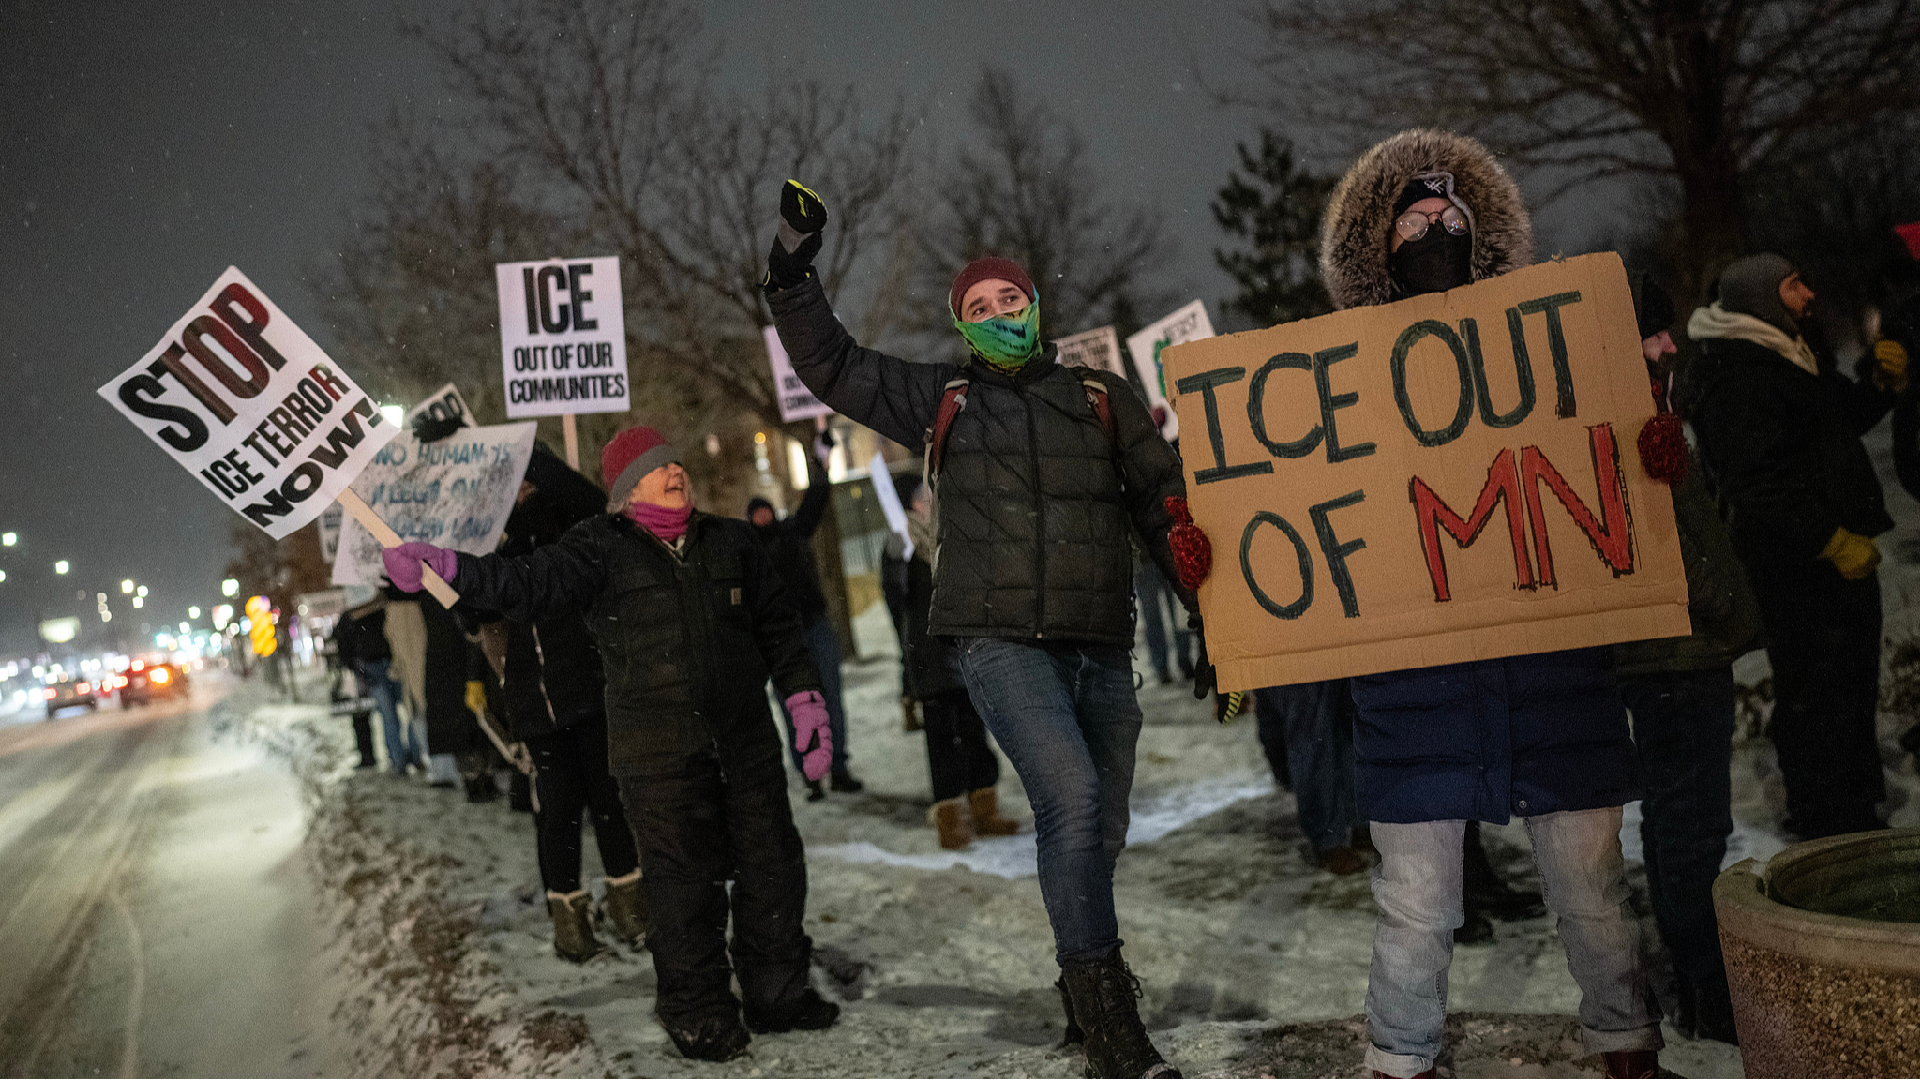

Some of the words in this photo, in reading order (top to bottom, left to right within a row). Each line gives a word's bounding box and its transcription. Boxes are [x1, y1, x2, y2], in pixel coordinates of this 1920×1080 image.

[514, 345, 548, 372] OUT
[552, 344, 574, 370] OF
[577, 342, 613, 369] OUR
[522, 263, 599, 335] ICE
[118, 282, 288, 452] STOP
[201, 448, 265, 500] ICE
[241, 362, 351, 469] TERROR
[510, 374, 625, 403] COMMUNITIES
[1177, 341, 1377, 485] ICE
[1390, 291, 1582, 447] OUT
[241, 397, 384, 528] NOW!
[374, 442, 407, 467] NO
[418, 442, 484, 466] HUMAN
[1239, 489, 1367, 620] OF
[1408, 423, 1635, 602] MN
